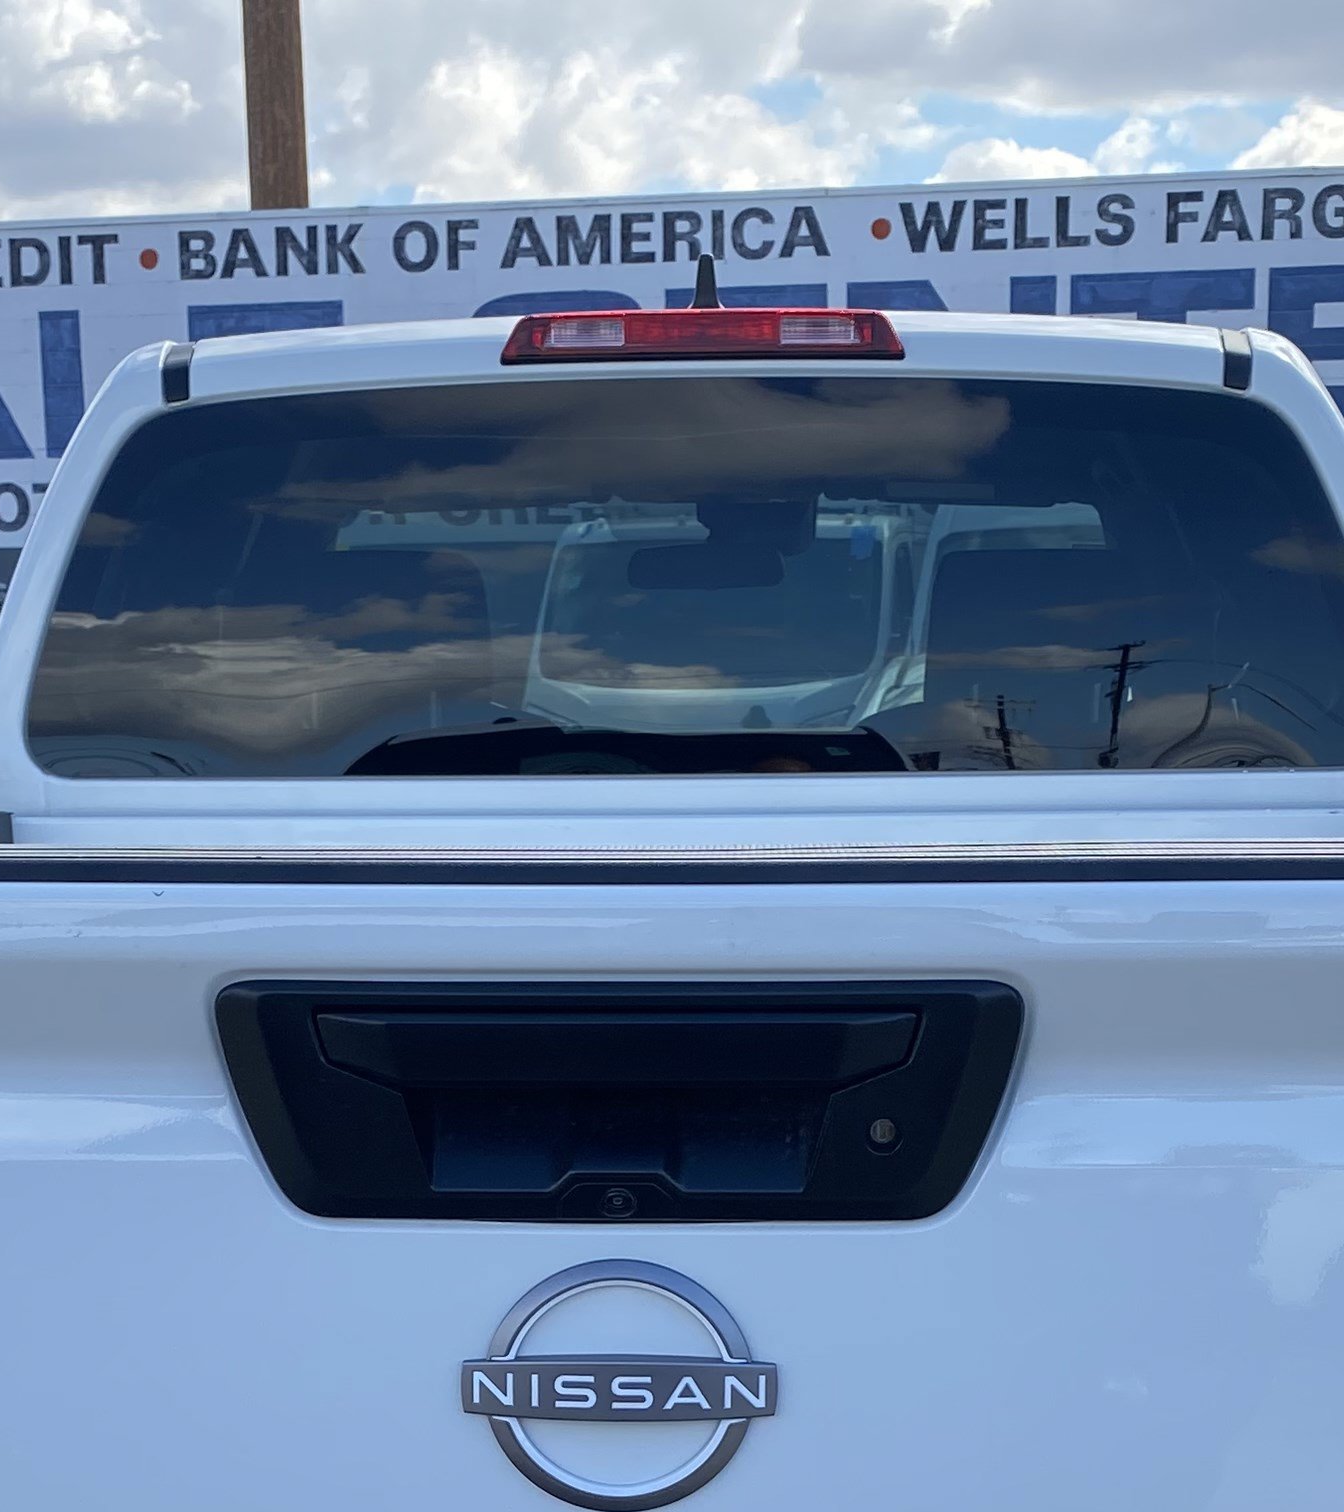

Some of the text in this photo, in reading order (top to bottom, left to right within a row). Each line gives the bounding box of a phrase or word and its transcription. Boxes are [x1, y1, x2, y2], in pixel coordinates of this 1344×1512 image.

[178, 224, 365, 281] BANK
[393, 219, 478, 271] OF
[500, 206, 830, 269] AMERICA
[899, 194, 1135, 253] WELLS
[472, 1370, 766, 1410] NISSAN
